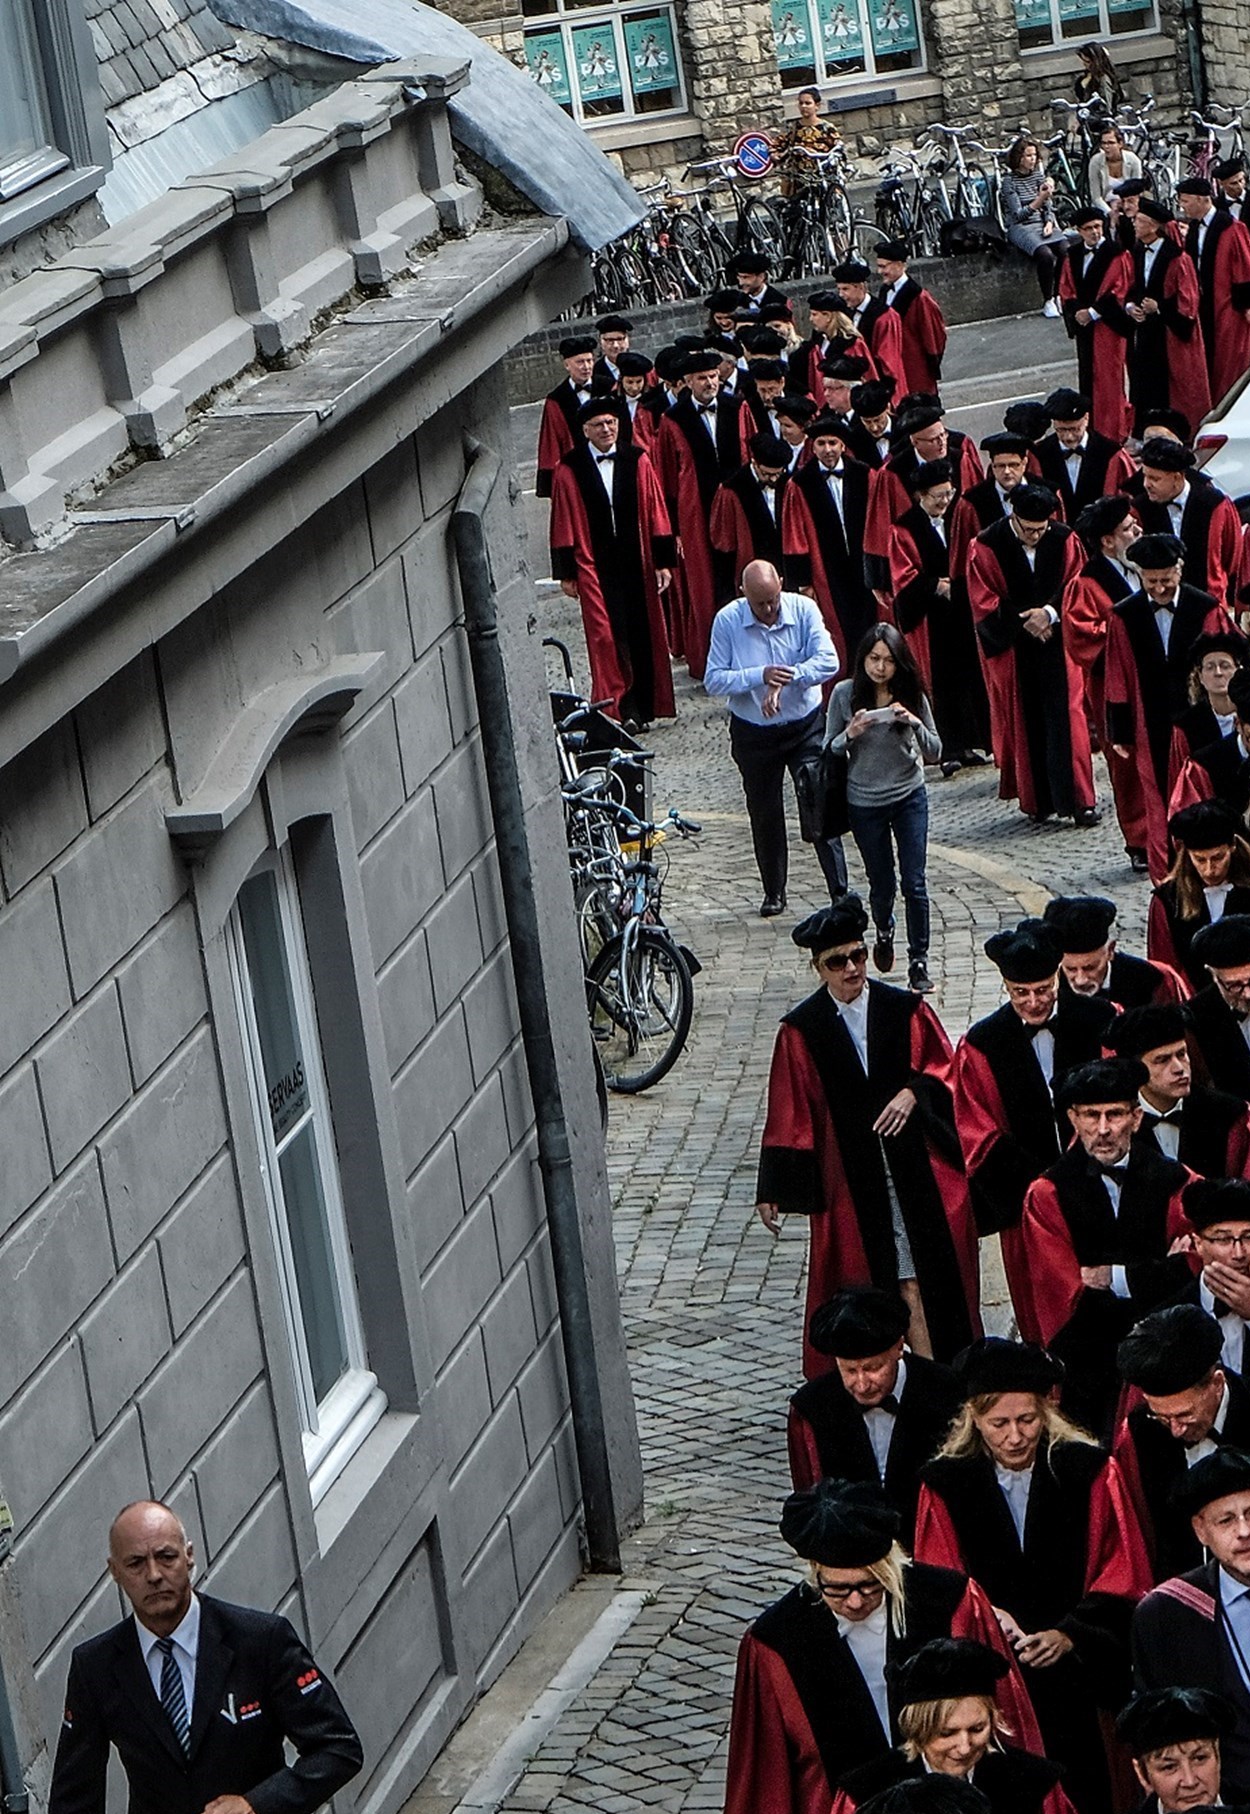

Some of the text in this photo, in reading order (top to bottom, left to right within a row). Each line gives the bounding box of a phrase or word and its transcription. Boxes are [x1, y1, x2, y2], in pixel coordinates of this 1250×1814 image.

[824, 20, 858, 37] PAS
[876, 14, 910, 30] PAS
[773, 30, 806, 45] PAS
[634, 51, 669, 68] PAS
[581, 60, 616, 77] PAS
